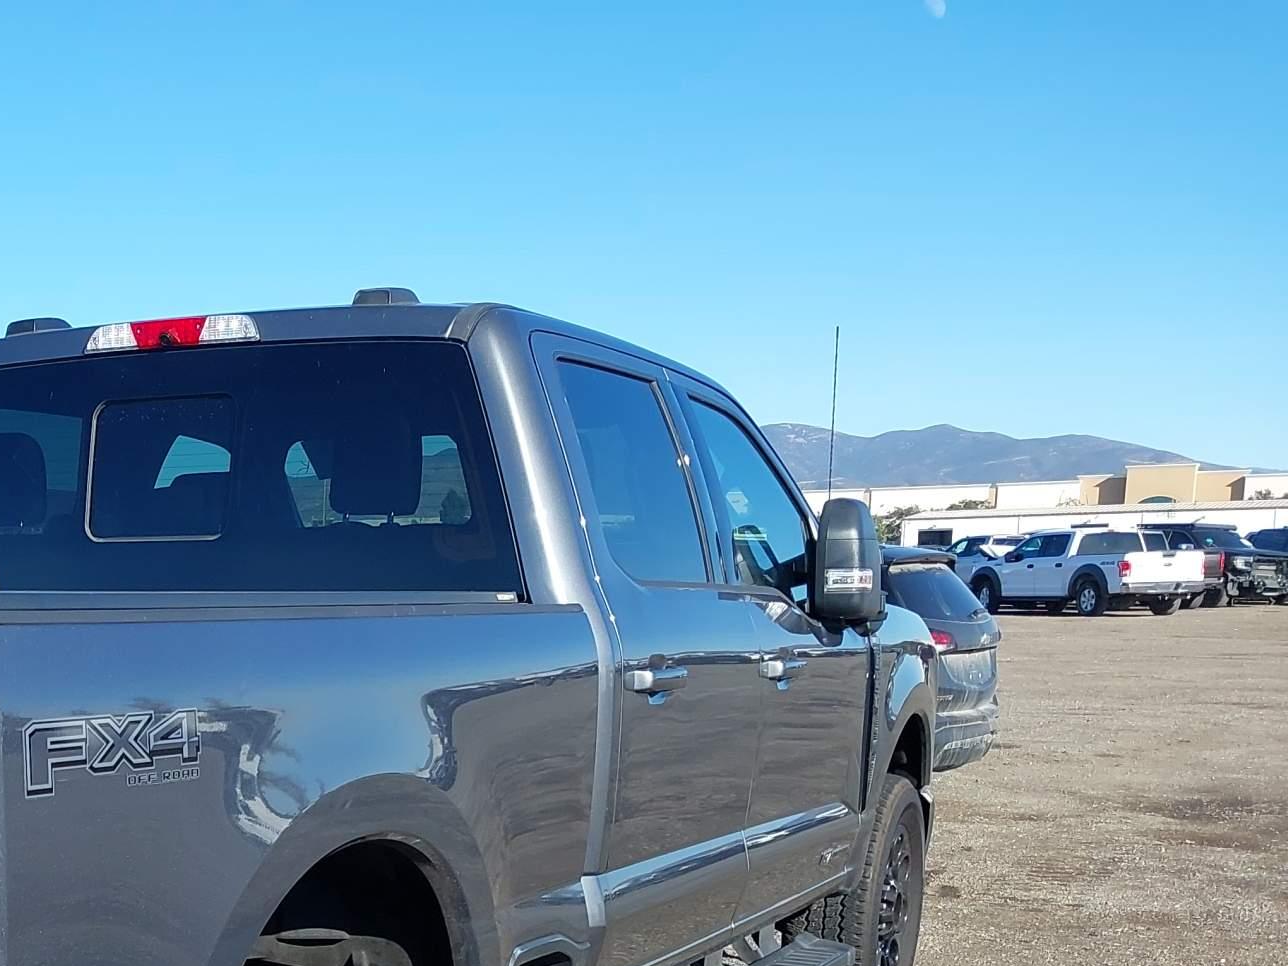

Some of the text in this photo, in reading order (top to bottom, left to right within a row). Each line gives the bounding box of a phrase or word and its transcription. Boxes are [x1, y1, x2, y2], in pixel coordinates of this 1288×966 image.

[22, 707, 202, 799] FX4
[127, 767, 201, 787] OFF ROAD
